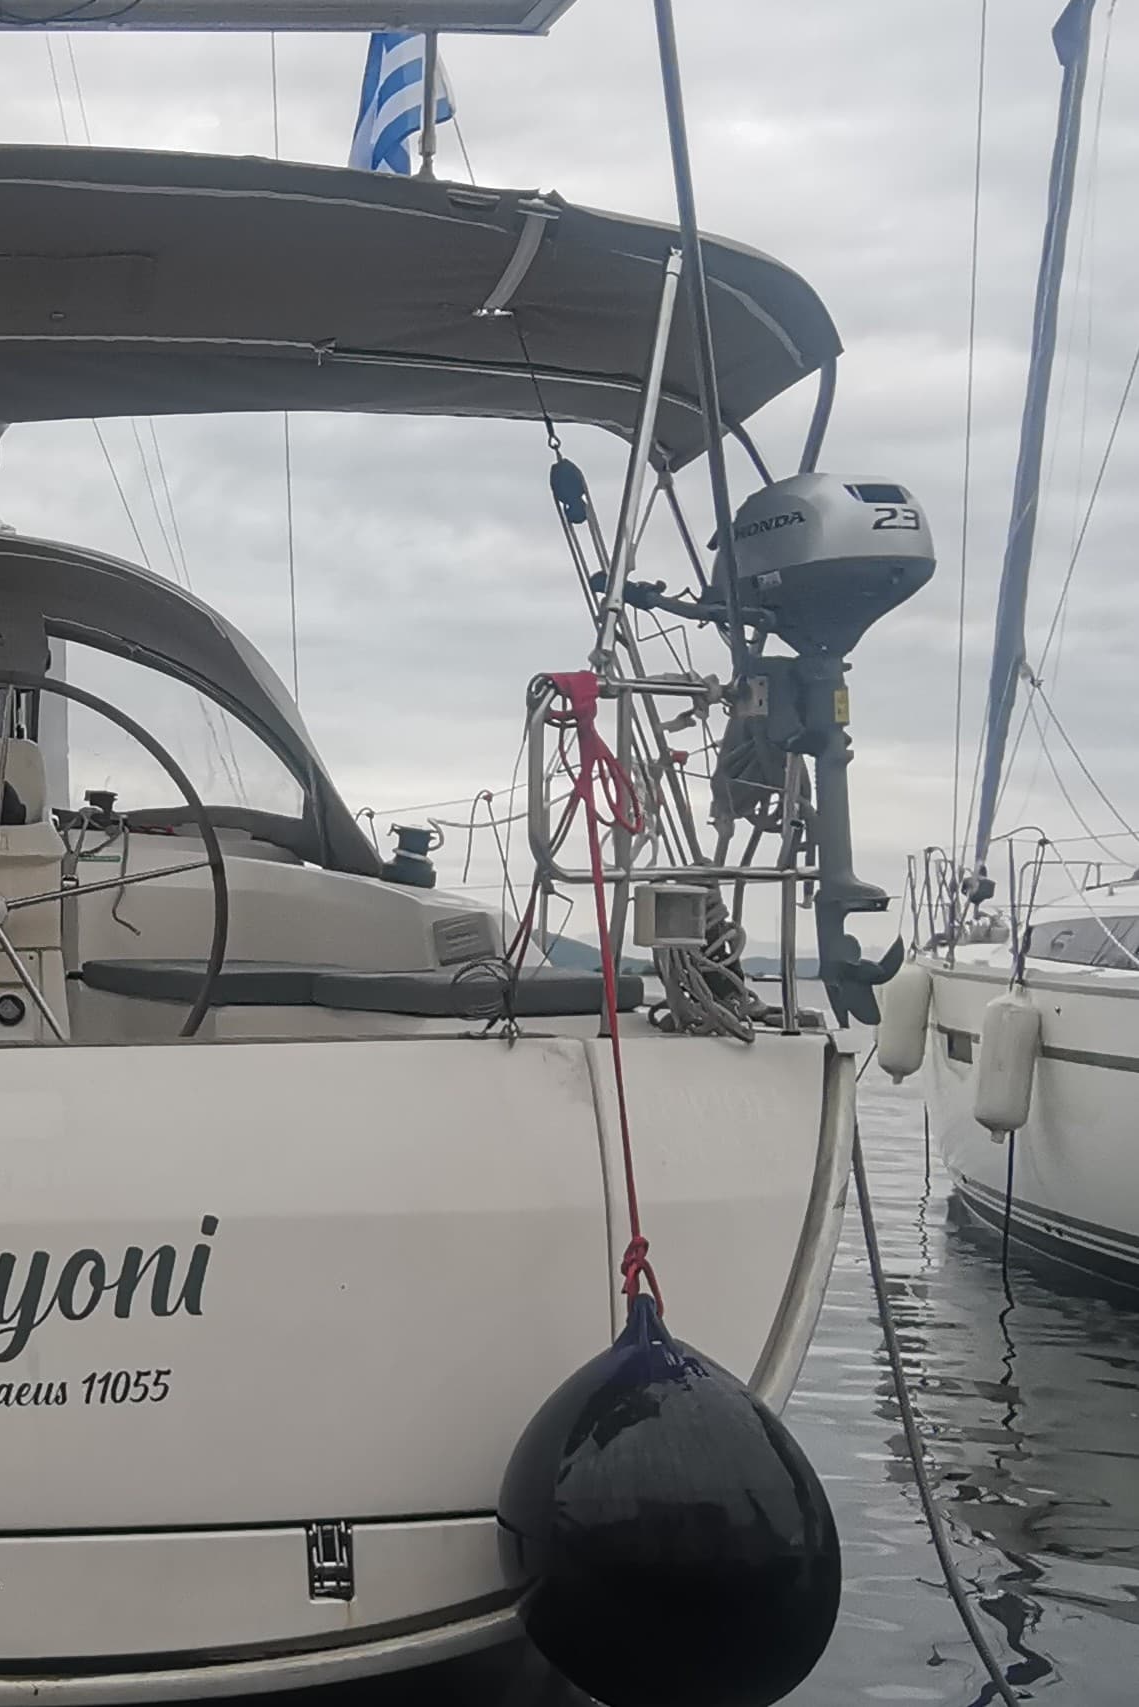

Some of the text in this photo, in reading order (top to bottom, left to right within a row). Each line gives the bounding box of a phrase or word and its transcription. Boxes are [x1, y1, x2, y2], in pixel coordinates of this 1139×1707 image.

[734, 511, 806, 541] HONDA
[872, 508, 920, 530] 23
[82, 1368, 172, 1405] 11055
